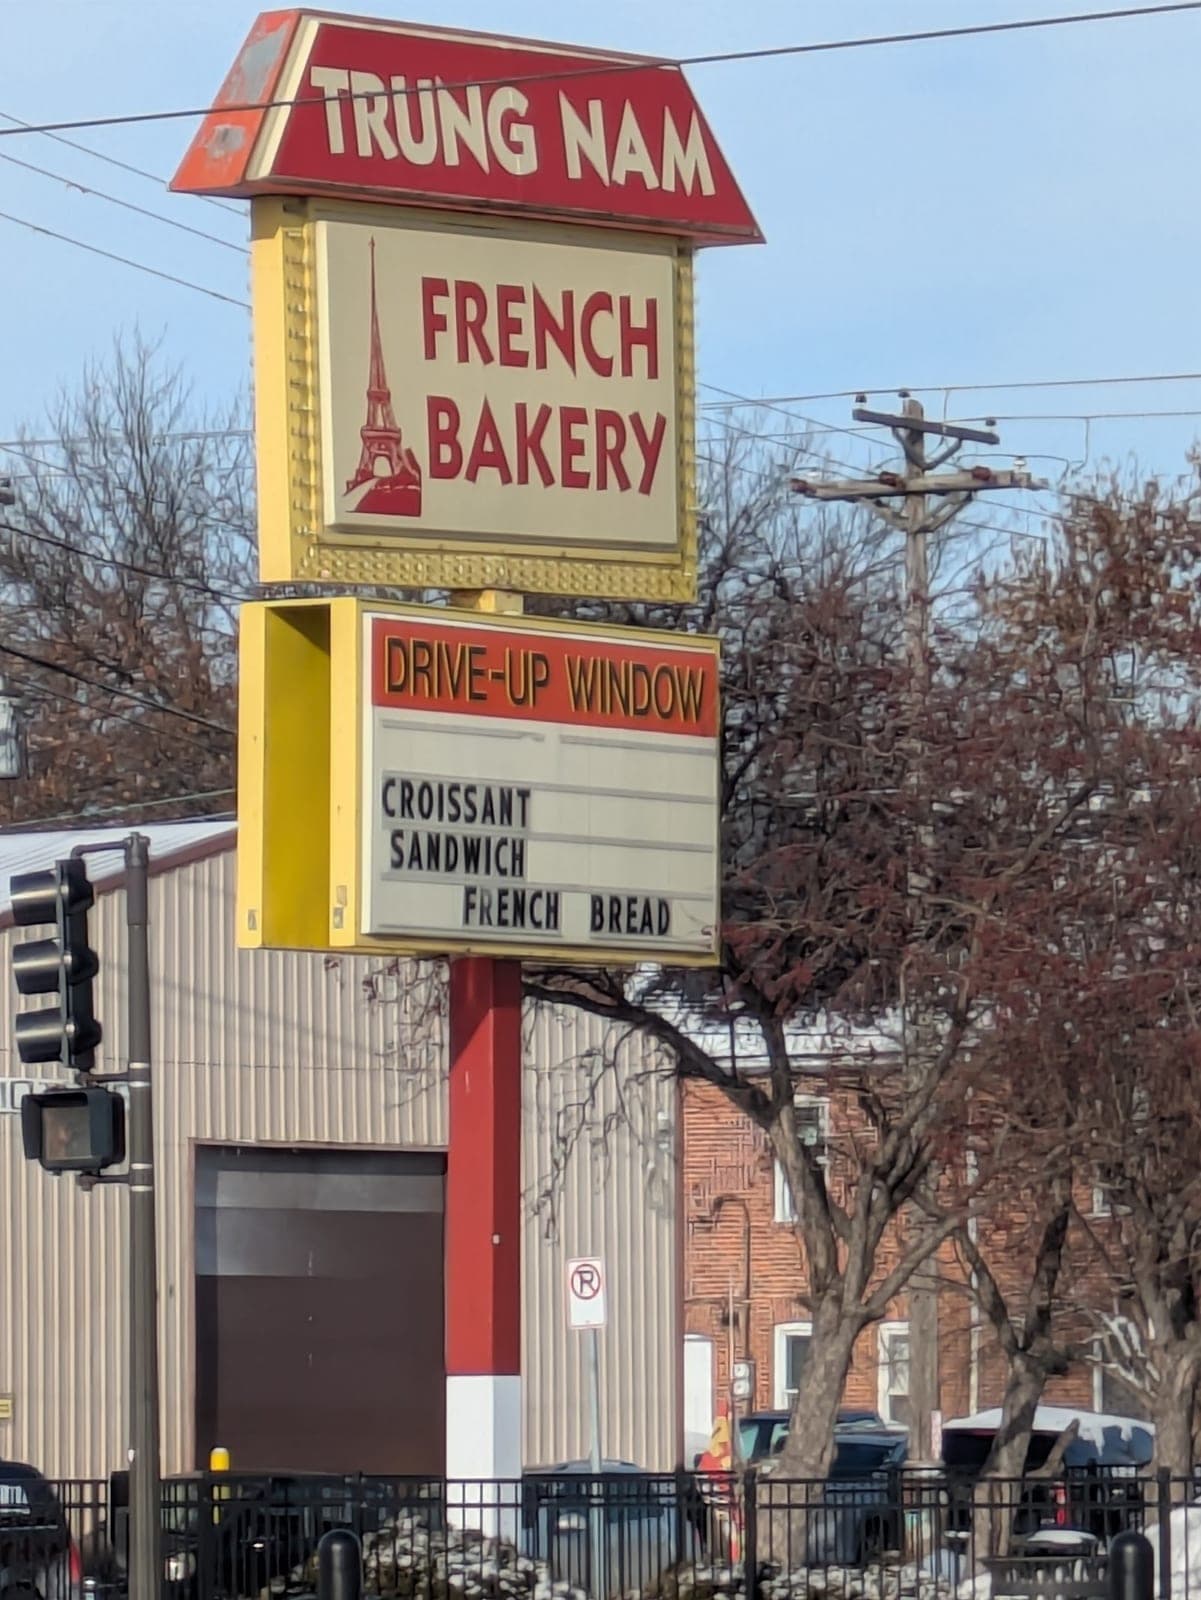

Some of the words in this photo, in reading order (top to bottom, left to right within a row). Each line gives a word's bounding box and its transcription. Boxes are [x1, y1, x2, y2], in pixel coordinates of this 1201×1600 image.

[310, 66, 538, 176] TRUNG
[558, 90, 716, 196] NAM
[421, 276, 659, 380] FRENCH
[426, 395, 667, 496] BAKERY
[384, 635, 549, 707] DRIVE-UP
[564, 653, 704, 723] WINDOW
[382, 777, 531, 828] CROISSANT
[390, 830, 525, 878] SANDWICH
[463, 885, 559, 930] FRENCH
[591, 894, 671, 936] BREAD
